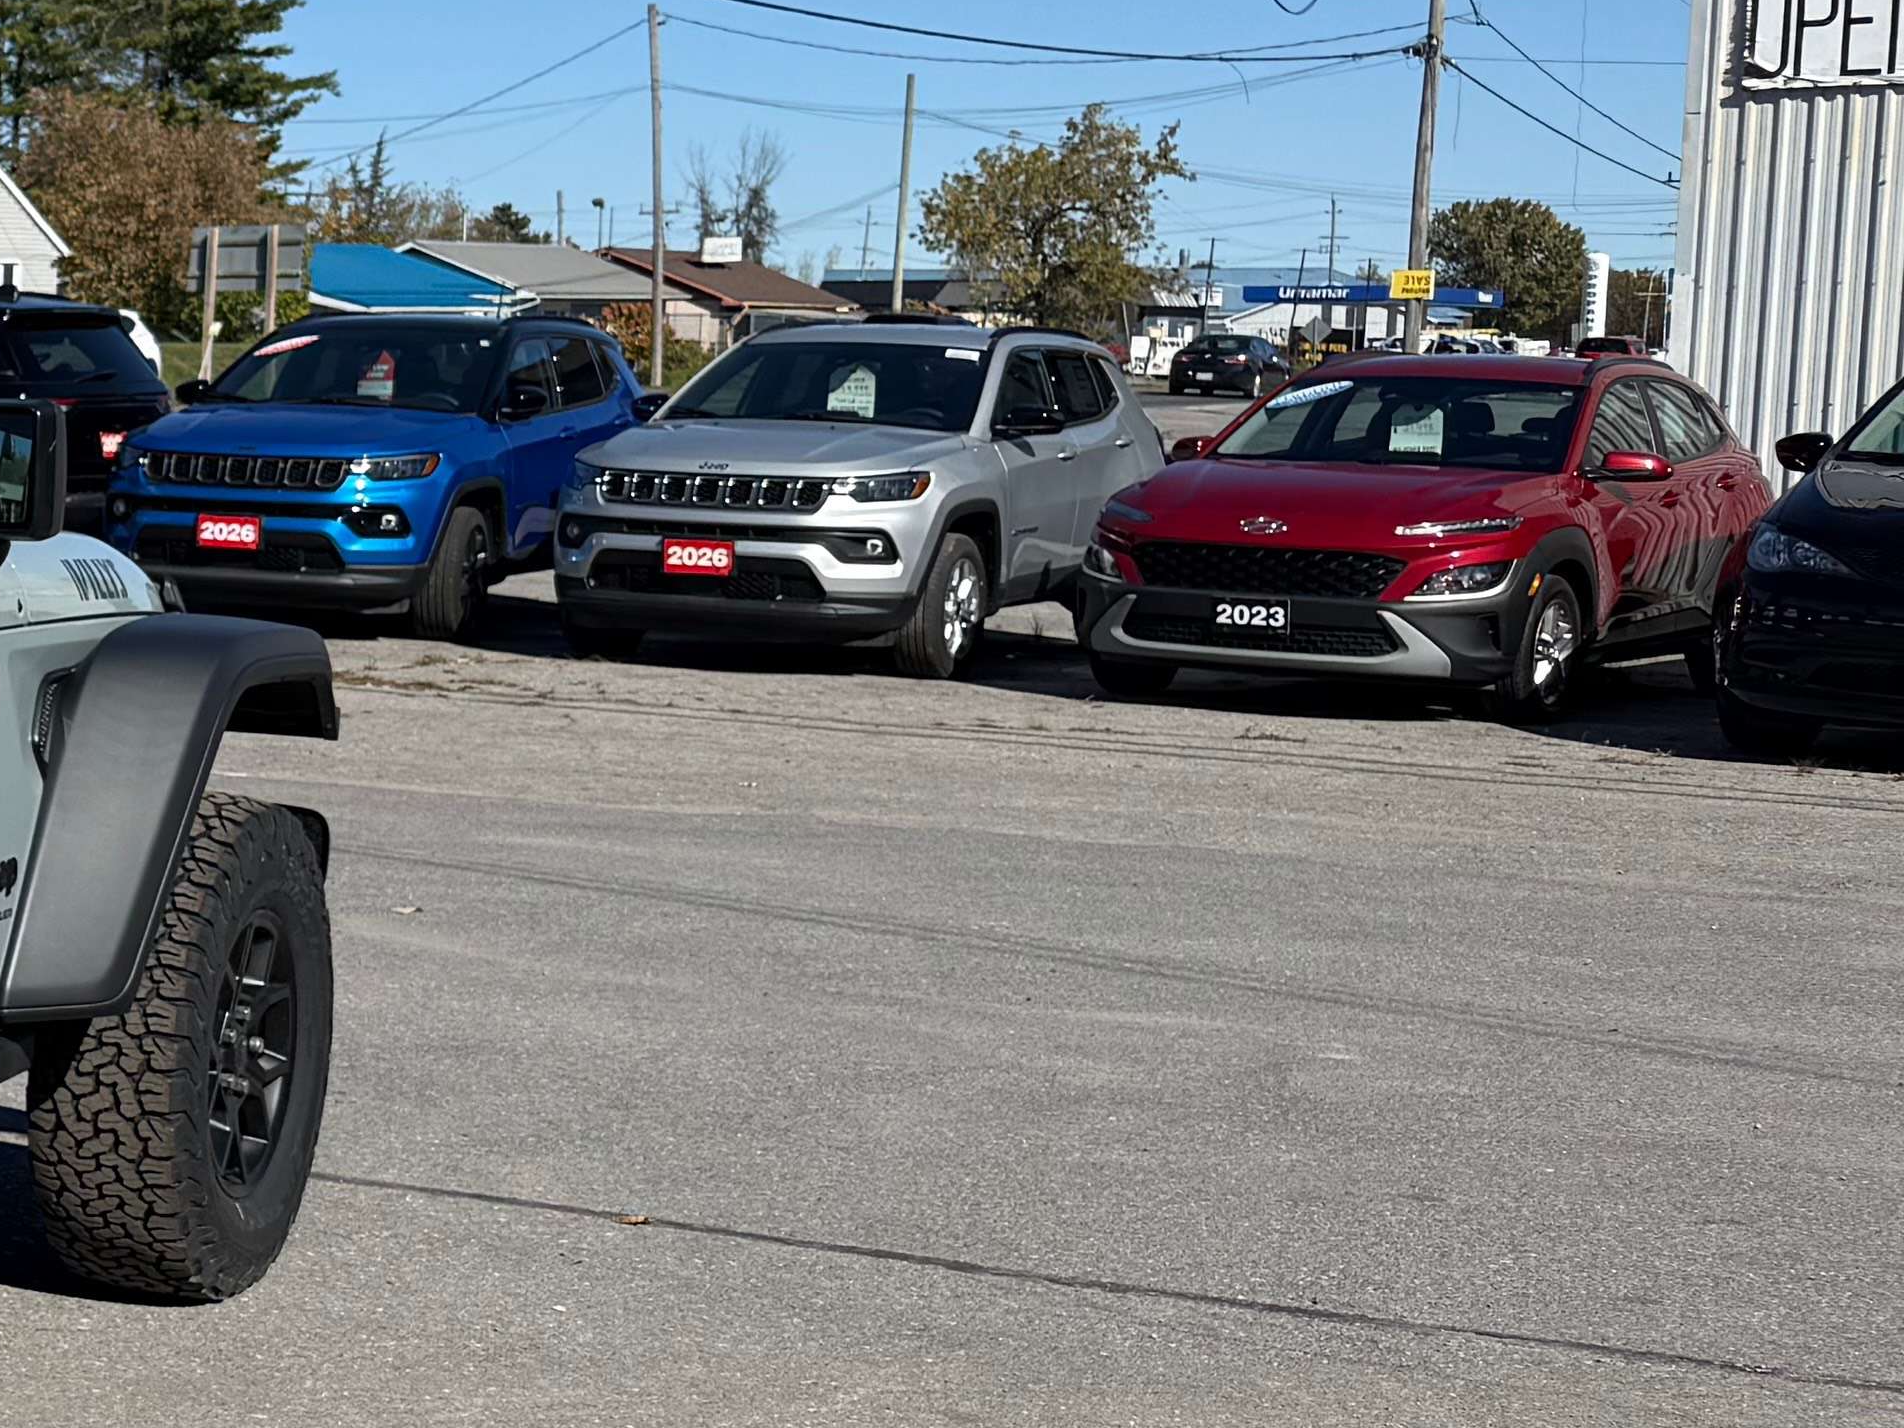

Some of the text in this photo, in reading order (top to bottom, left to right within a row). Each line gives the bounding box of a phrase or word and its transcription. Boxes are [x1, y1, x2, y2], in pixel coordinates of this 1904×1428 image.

[199, 522, 256, 543] 2026
[666, 546, 730, 568] 2026
[60, 558, 129, 601] WILLYS
[1215, 604, 1286, 628] 2023
